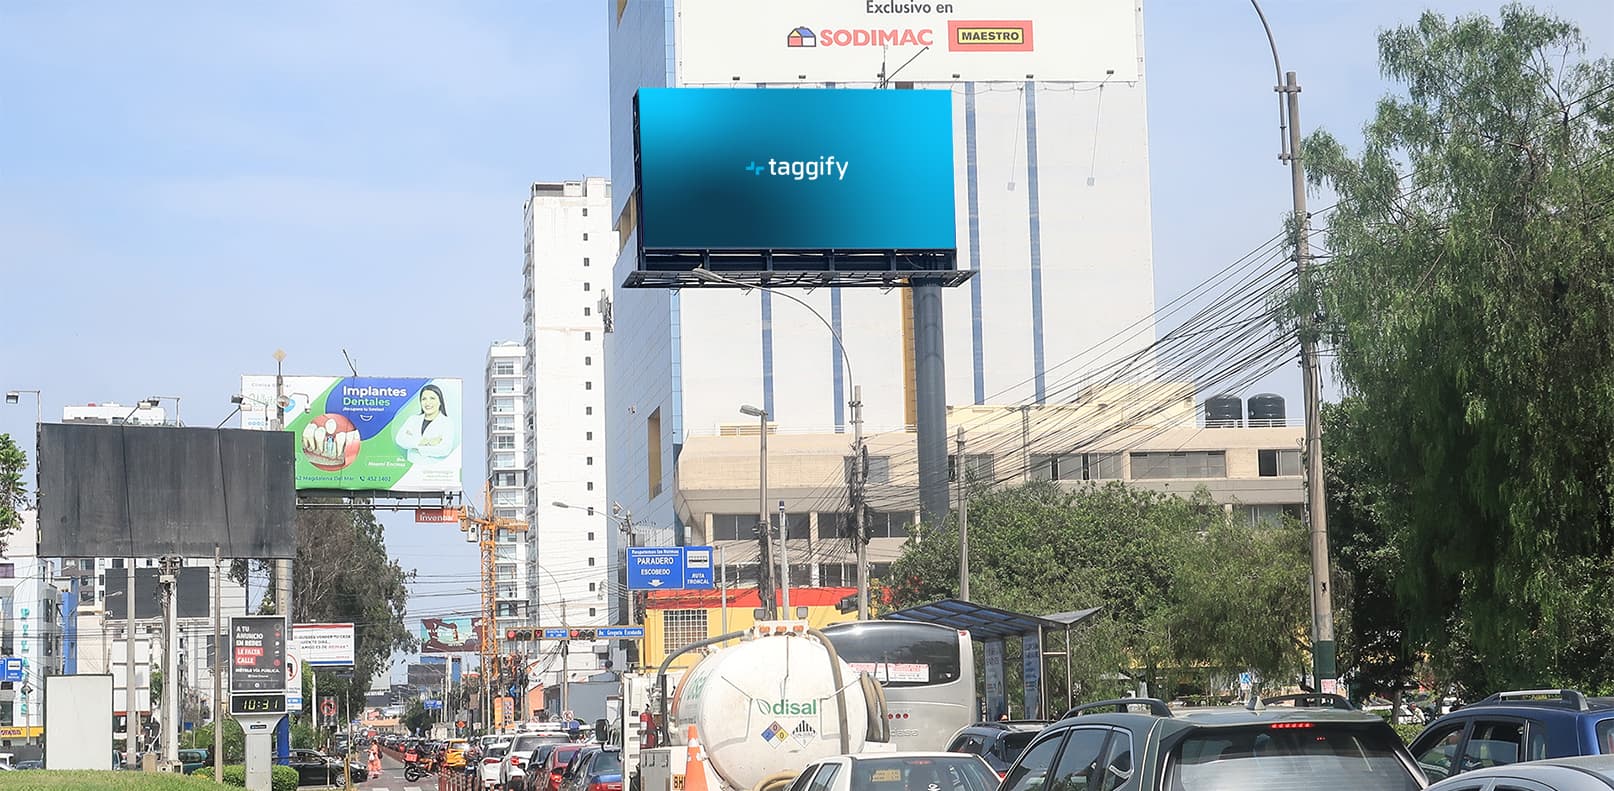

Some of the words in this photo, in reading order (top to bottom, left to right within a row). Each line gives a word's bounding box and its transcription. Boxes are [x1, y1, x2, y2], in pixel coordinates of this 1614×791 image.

[866, 0, 932, 15] Exclusivo
[936, 4, 954, 15] en
[820, 29, 933, 47] SODIMAC
[961, 31, 1019, 41] MAESTRO
[768, 155, 849, 181] taggify
[343, 385, 407, 398] Implantes
[343, 397, 391, 407] Dentales
[637, 557, 674, 565] PARADERO
[641, 568, 671, 576] ESCOBEDO
[243, 700, 278, 710] 10:31
[772, 698, 817, 715] disal
[779, 731, 785, 739] 0
